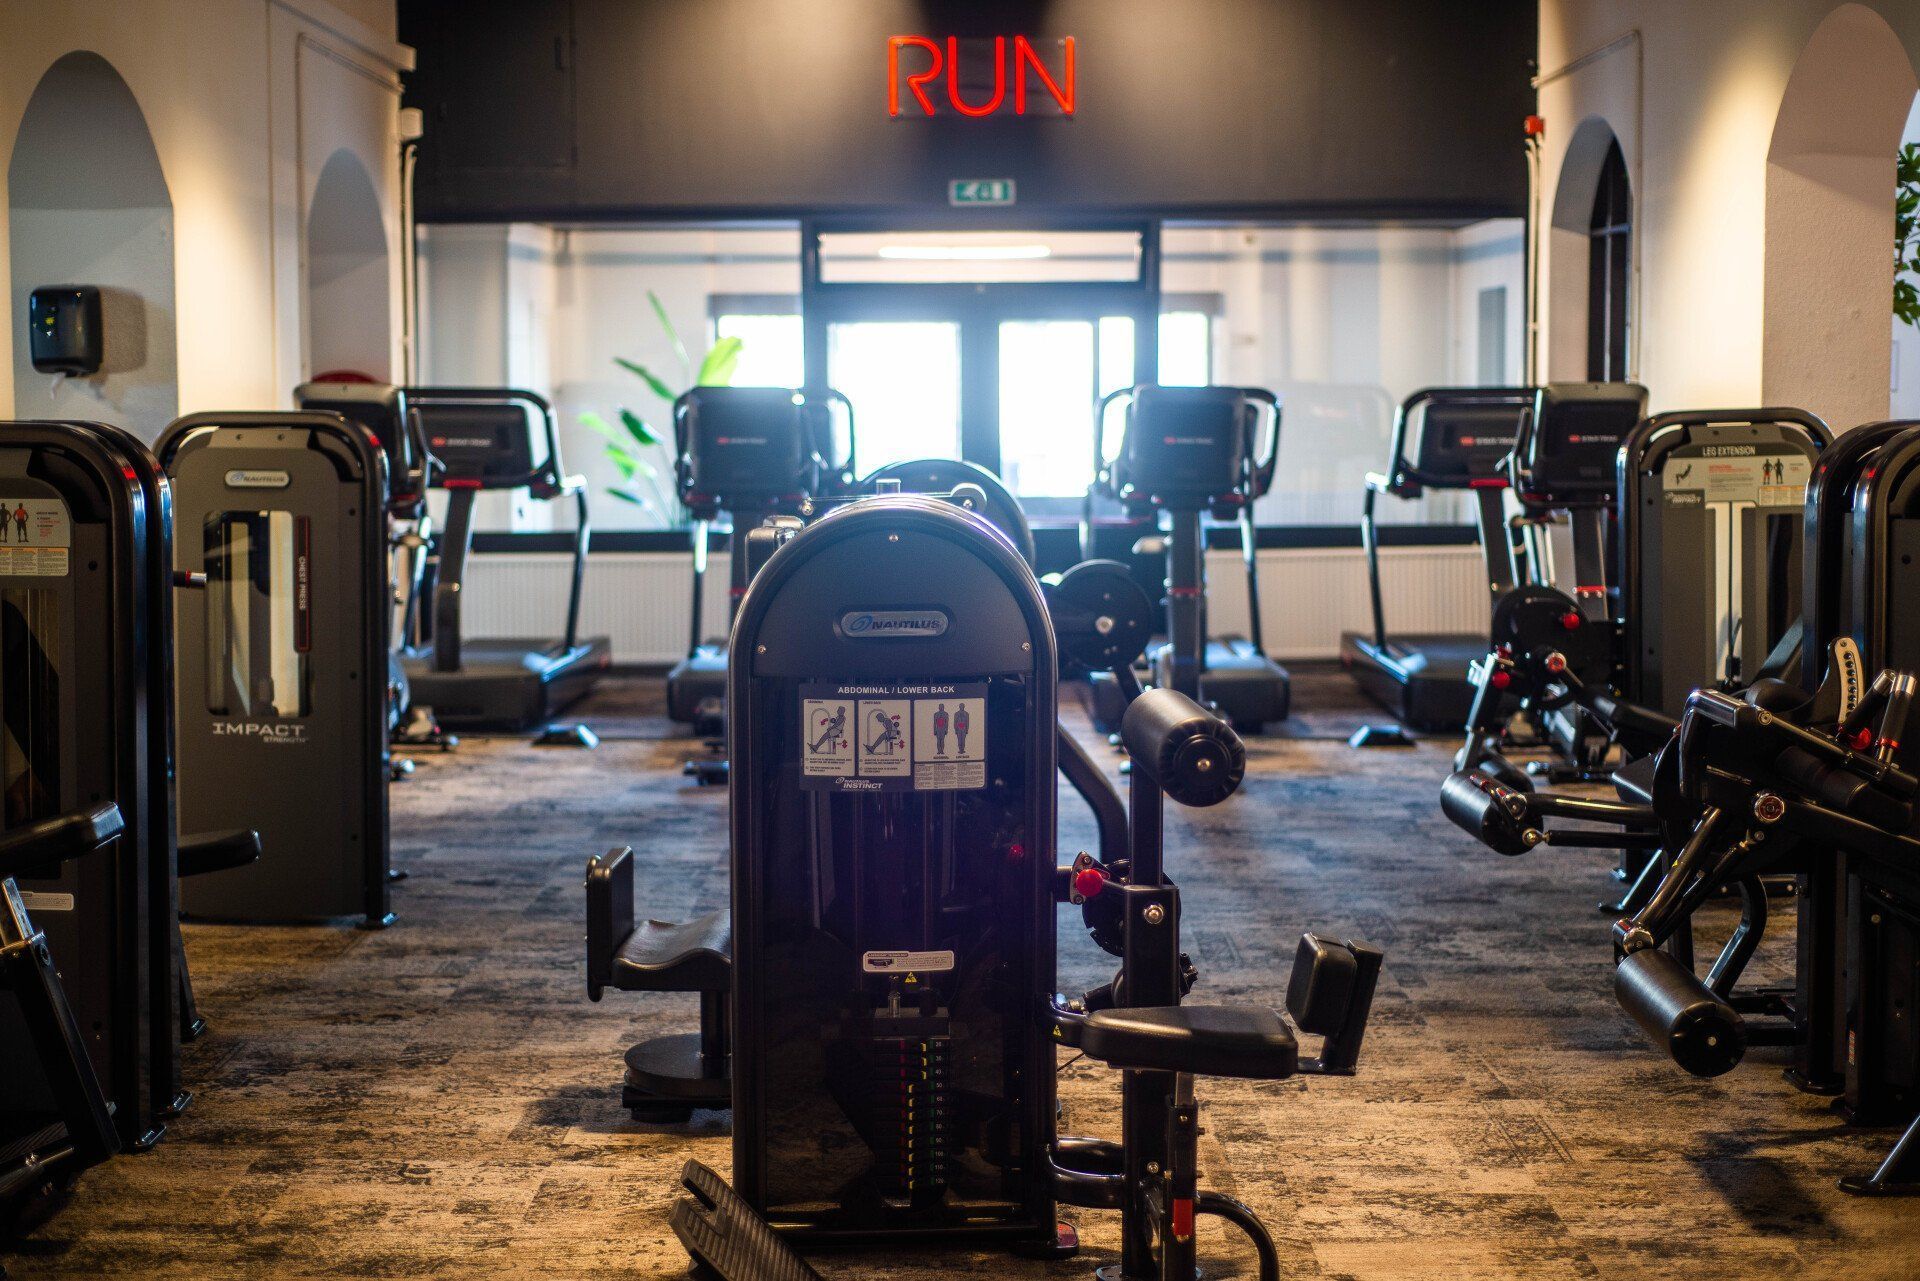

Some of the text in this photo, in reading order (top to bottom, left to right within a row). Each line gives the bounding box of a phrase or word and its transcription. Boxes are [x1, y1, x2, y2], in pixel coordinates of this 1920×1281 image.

[888, 35, 1075, 117] RUN
[1702, 446, 1756, 457] LEG EXTENSION
[872, 619, 940, 629] NAUTILUS
[837, 685, 955, 694] ABDOMINAL / LOWER BACK
[212, 722, 305, 736] IMPACT
